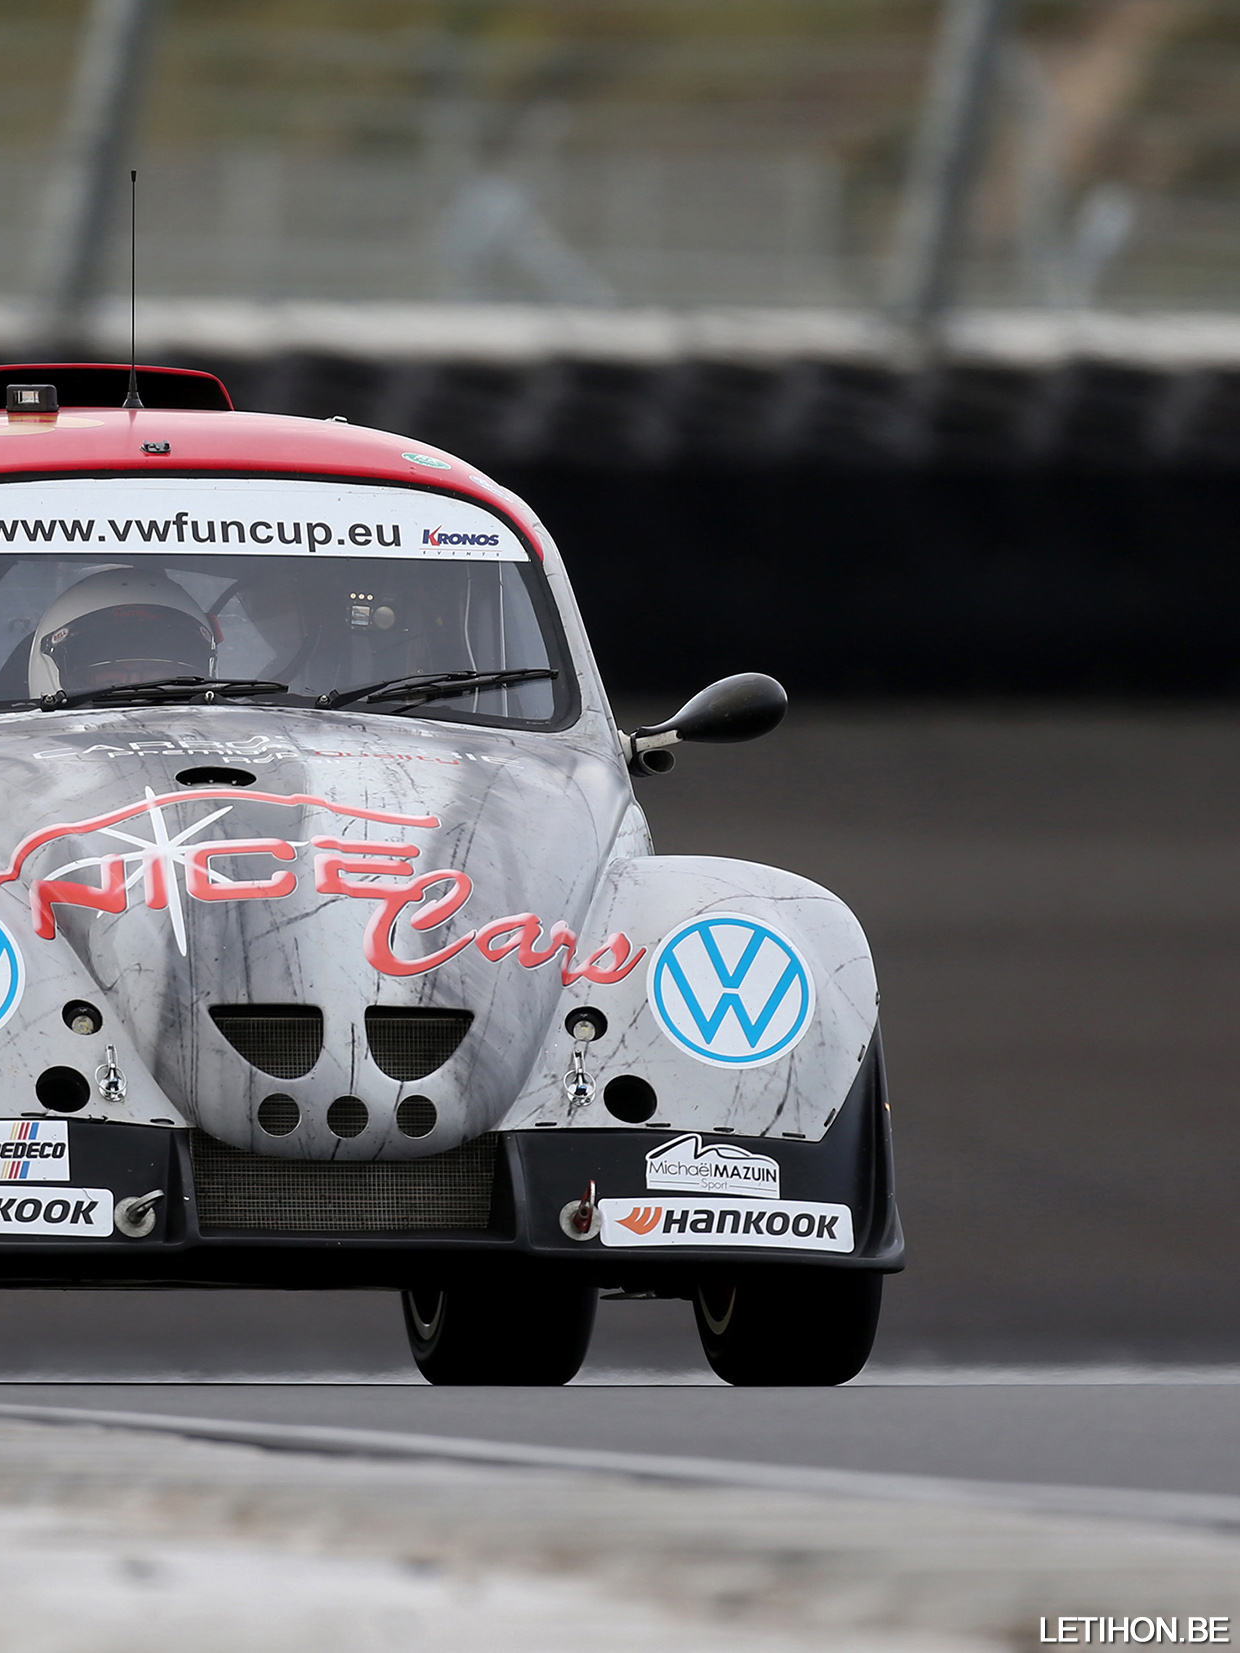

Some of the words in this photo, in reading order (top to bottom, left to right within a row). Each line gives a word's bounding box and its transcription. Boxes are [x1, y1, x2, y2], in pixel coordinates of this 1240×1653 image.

[422, 525, 499, 546] KRONOS
[31, 836, 423, 940] NICE
[360, 869, 647, 986] Cars
[655, 920, 807, 1058] VW
[701, 1177, 728, 1191] Sport
[662, 1208, 840, 1240] HANKOOK
